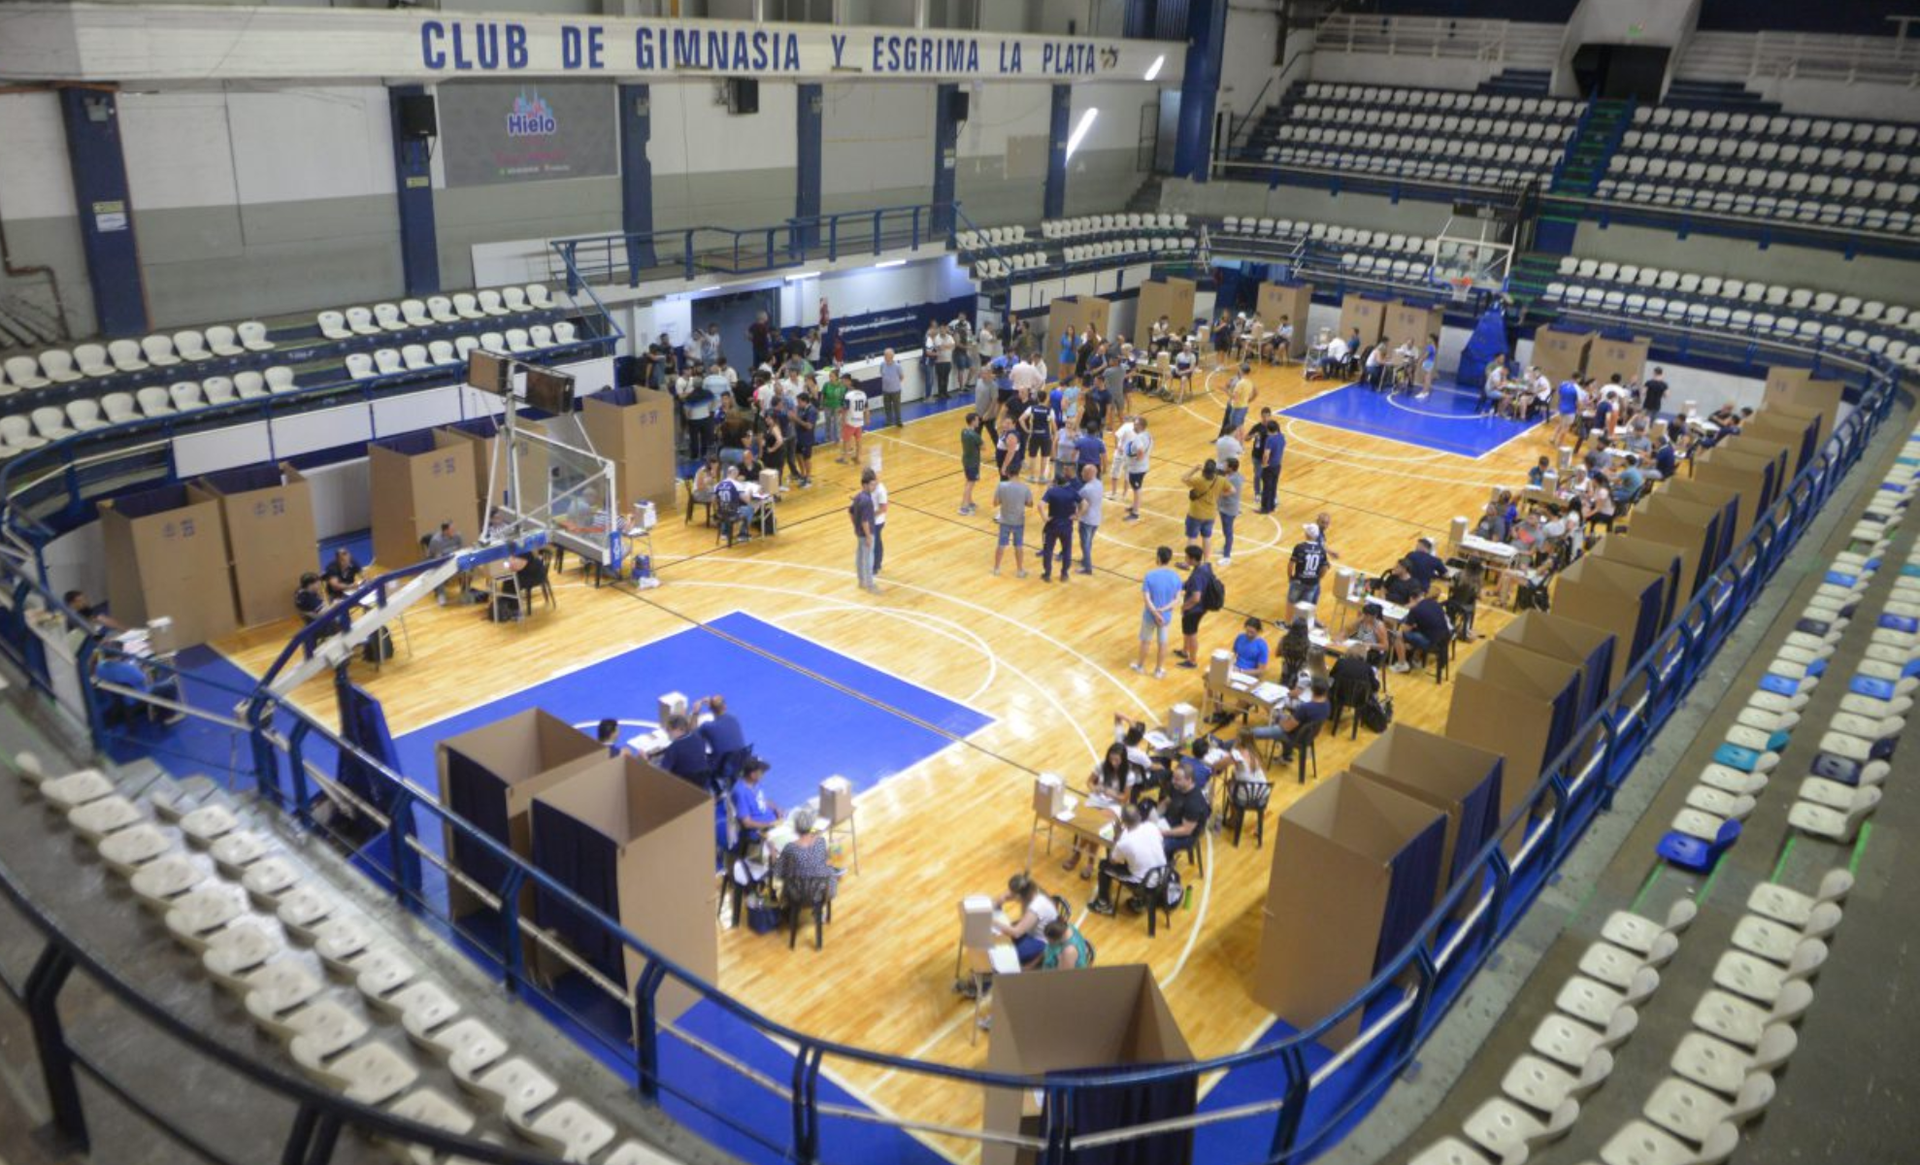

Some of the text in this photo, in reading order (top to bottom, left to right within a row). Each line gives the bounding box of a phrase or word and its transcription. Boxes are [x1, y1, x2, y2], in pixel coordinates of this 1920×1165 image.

[421, 20, 1095, 74] CLUB DE GIMNASIA Y ESGRIMA LA PLATA
[508, 114, 555, 135] Hielo
[854, 399, 864, 412] 10
[1305, 554, 1320, 571] 10
